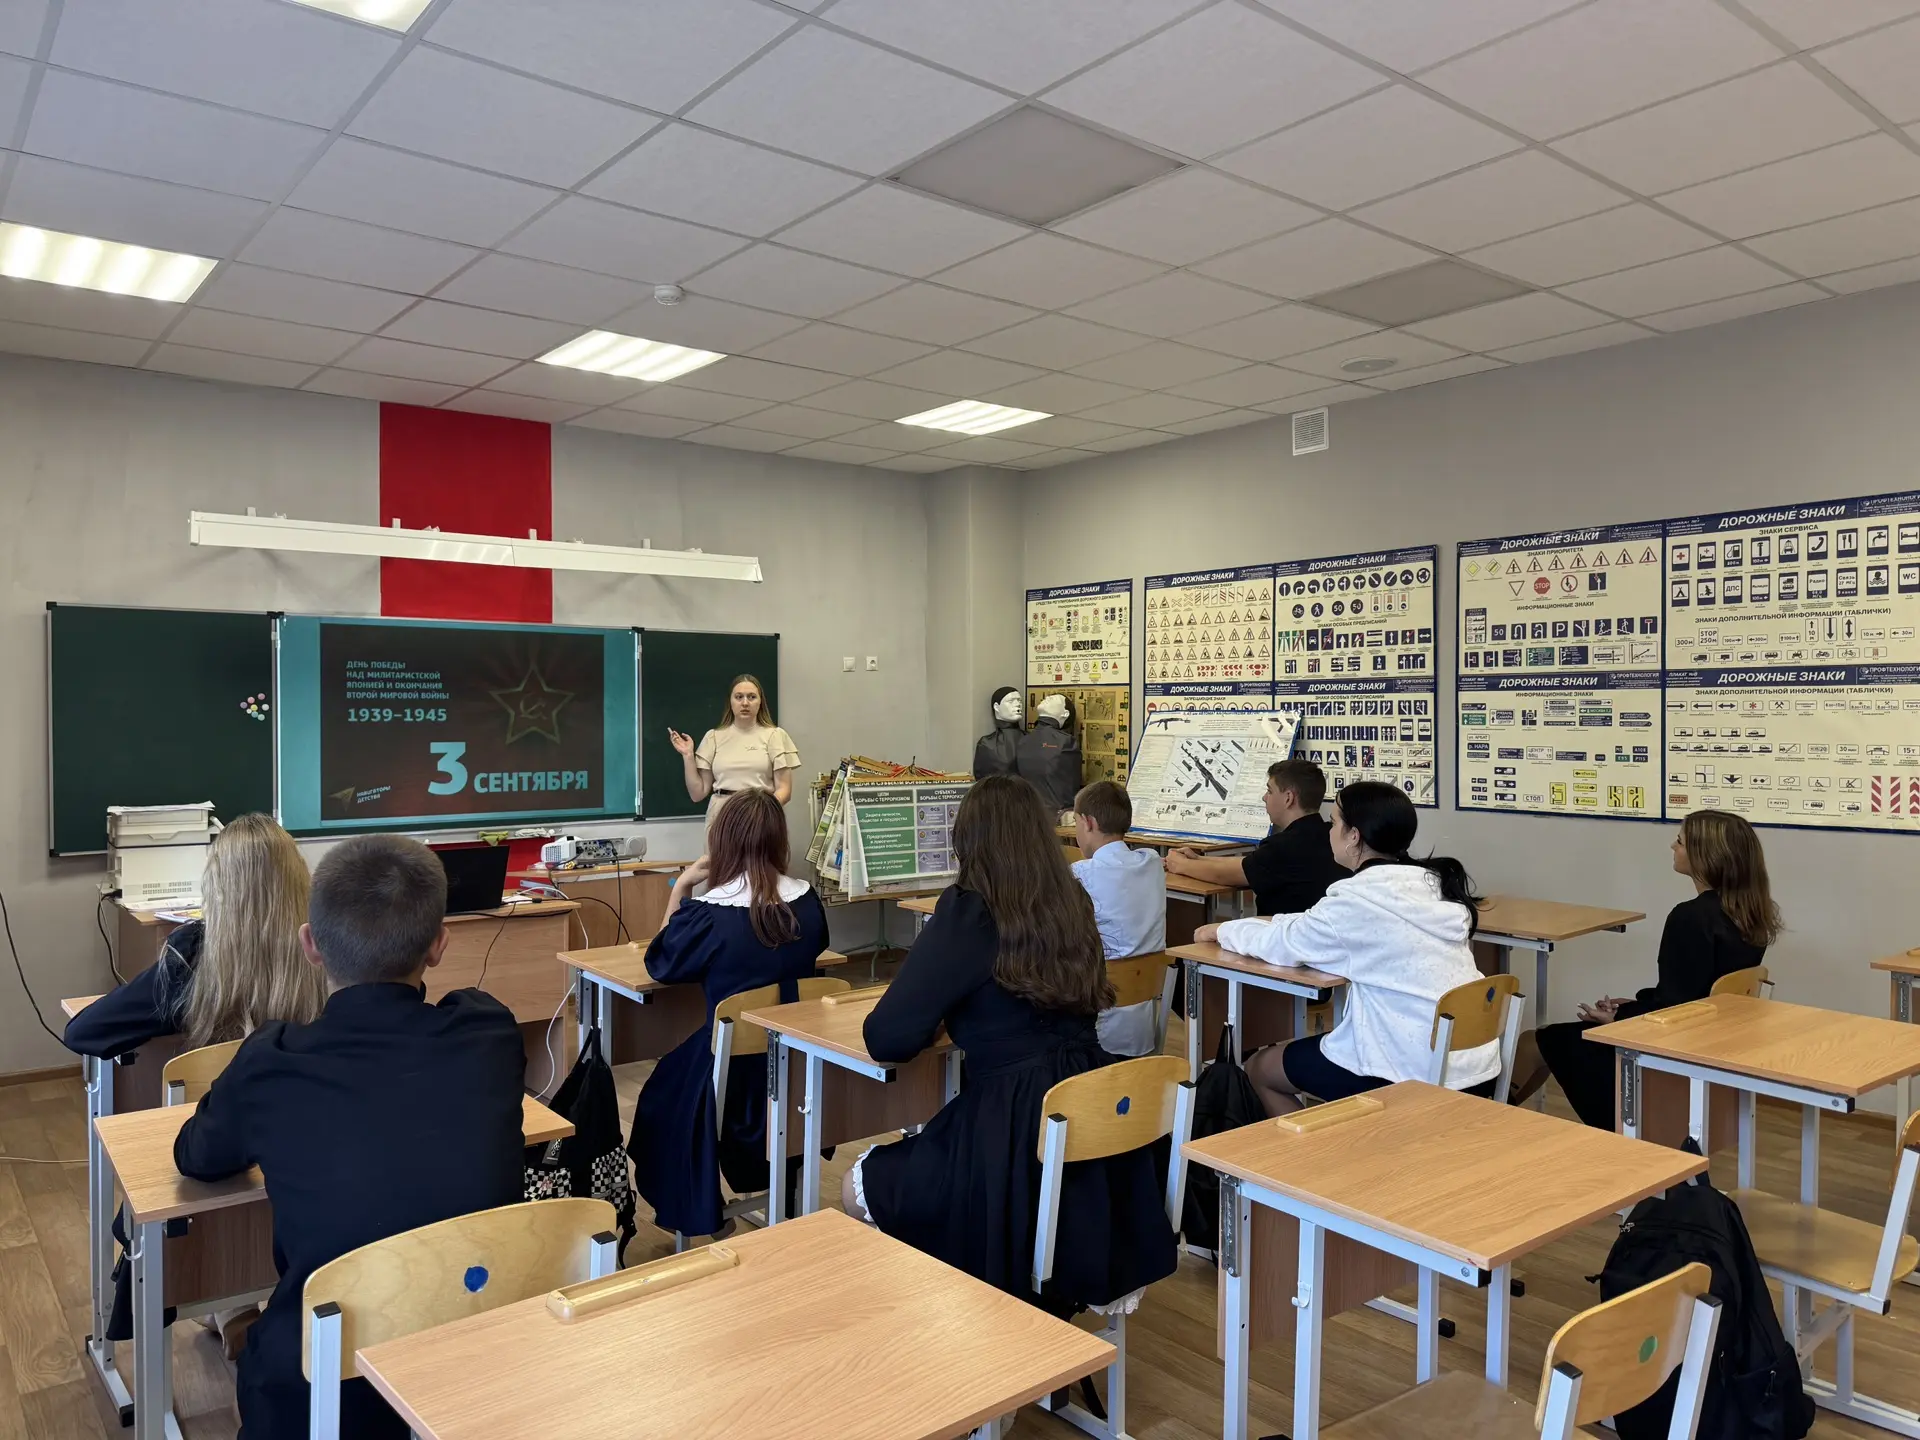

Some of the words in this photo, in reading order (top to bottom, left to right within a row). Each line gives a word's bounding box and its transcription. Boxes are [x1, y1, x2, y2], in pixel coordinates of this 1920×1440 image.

[1718, 510, 1797, 529] ДОРОЖНЫЕ
[1799, 505, 1846, 519] ЗНАКИ
[1759, 527, 1782, 535] ЗНАКИ
[1785, 524, 1818, 532] СЕРВИСА
[1501, 534, 1561, 550] ДОРОЖНЫЕ
[1562, 531, 1599, 544] ЗНАКИ
[1547, 547, 1584, 555] ПРИОРИТЕТА
[1308, 557, 1358, 572] ДОРОЖНЫЕ
[1359, 554, 1386, 565] ЗНАКИ
[1171, 574, 1210, 585] ДОРОЖНЫЕ
[1211, 572, 1234, 580] ЗНАКИ
[1049, 587, 1080, 597] ДОРОЖНЫЕ
[1516, 602, 1574, 611] ИНФОРМАЦИОННЫЕ
[1718, 612, 1786, 622] ДОПОЛНИТЕЛЬНОЙ
[1788, 610, 1843, 618] ИНФОРМАЦИИ
[1845, 608, 1891, 616] (ТАБЛИЧКИ)
[1556, 624, 1565, 636] P
[371, 662, 406, 670] ПОБЕДЫ
[367, 671, 441, 680] МИЛИТАРИСТСКОЙ
[1718, 673, 1798, 684] ДОРОЖНЫЕ
[1799, 671, 1846, 682] ЗНАКИ
[346, 680, 384, 689] ЯПОНИЕЙ
[1308, 684, 1357, 692] ДОРОЖНЫЕ
[1358, 683, 1386, 691] ЗНАКИ
[1499, 678, 1561, 688] ДОРОЖНЫЕ
[1562, 677, 1598, 686] ЗНАКИ
[346, 690, 378, 699] ВТОРОЙ
[380, 691, 419, 699] МИРОВОЙ
[421, 691, 449, 699] ВОЙНЫ
[428, 742, 468, 795] 3
[473, 770, 588, 793] СЕНТЯБРЯ
[1336, 779, 1342, 787] P
